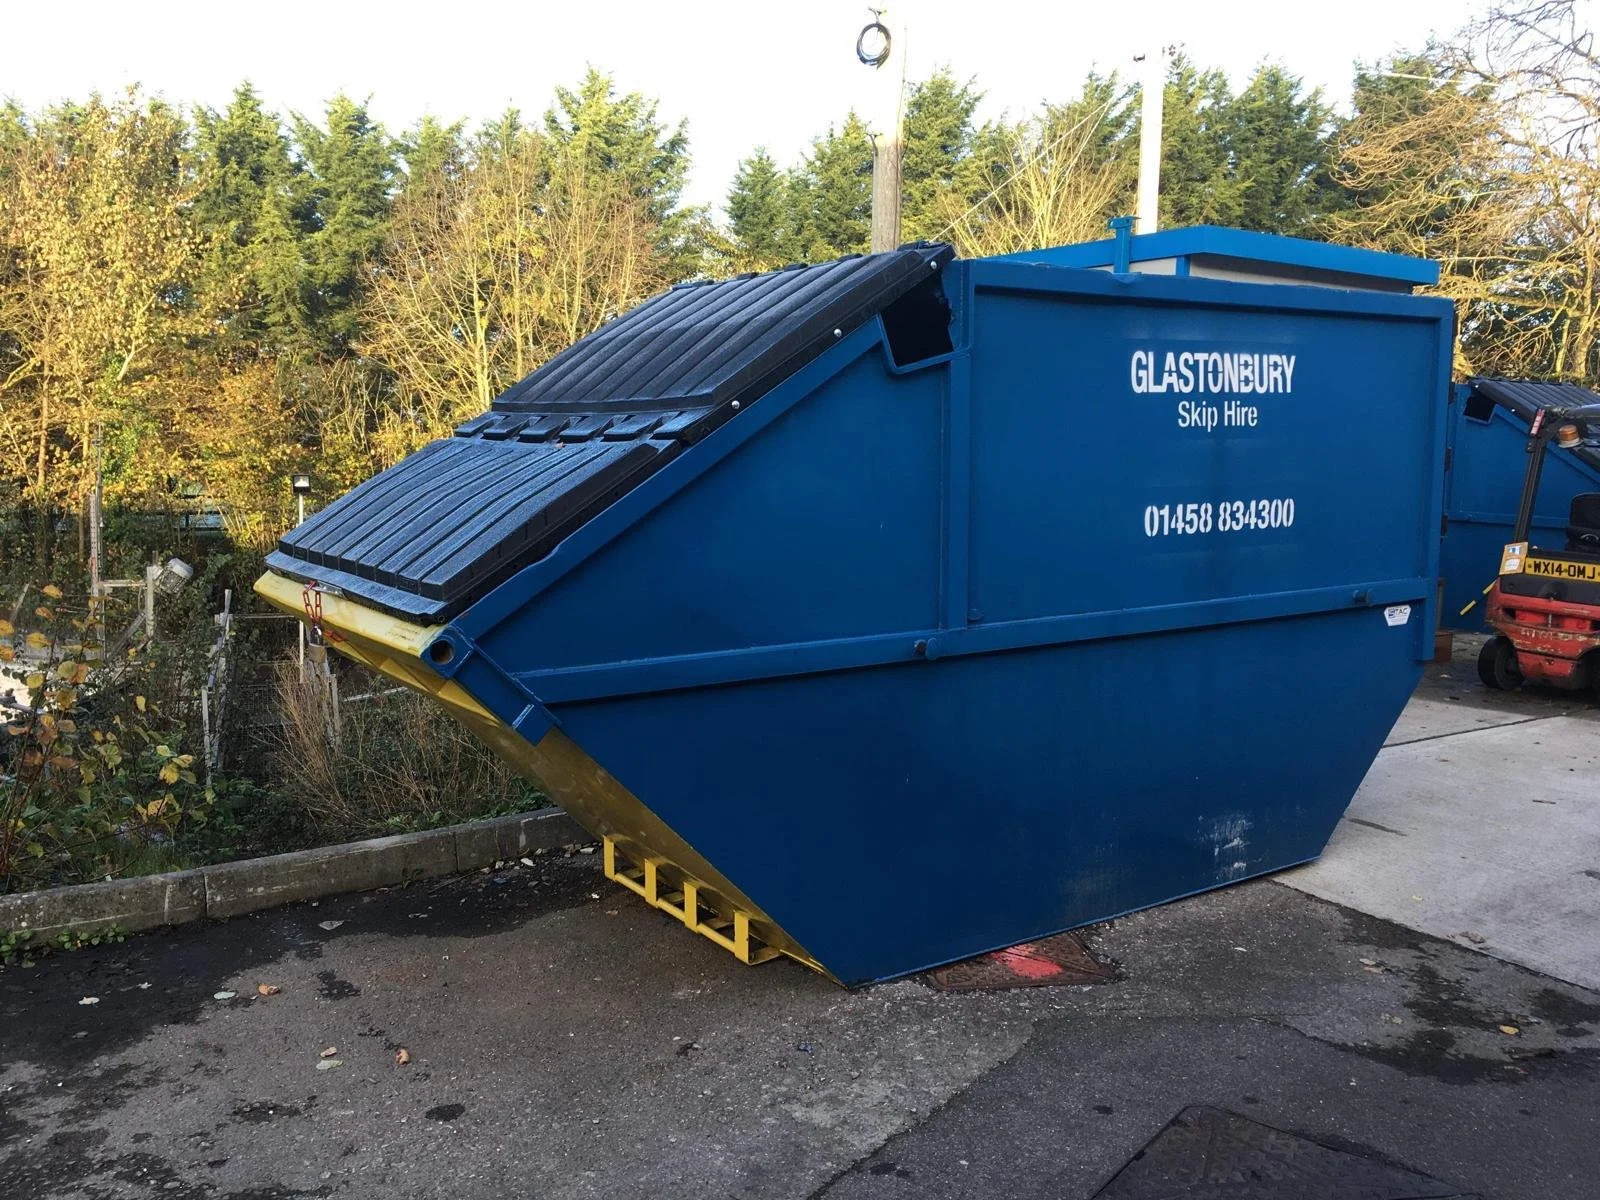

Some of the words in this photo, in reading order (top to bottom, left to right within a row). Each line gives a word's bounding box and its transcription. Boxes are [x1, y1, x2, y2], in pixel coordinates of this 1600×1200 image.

[1131, 350, 1296, 394] GLASTONBURY
[1178, 401, 1218, 432] Skip
[1224, 401, 1257, 426] Hire
[1144, 502, 1212, 536] 01458
[1218, 498, 1295, 531] 834300
[1533, 560, 1563, 576] WX14
